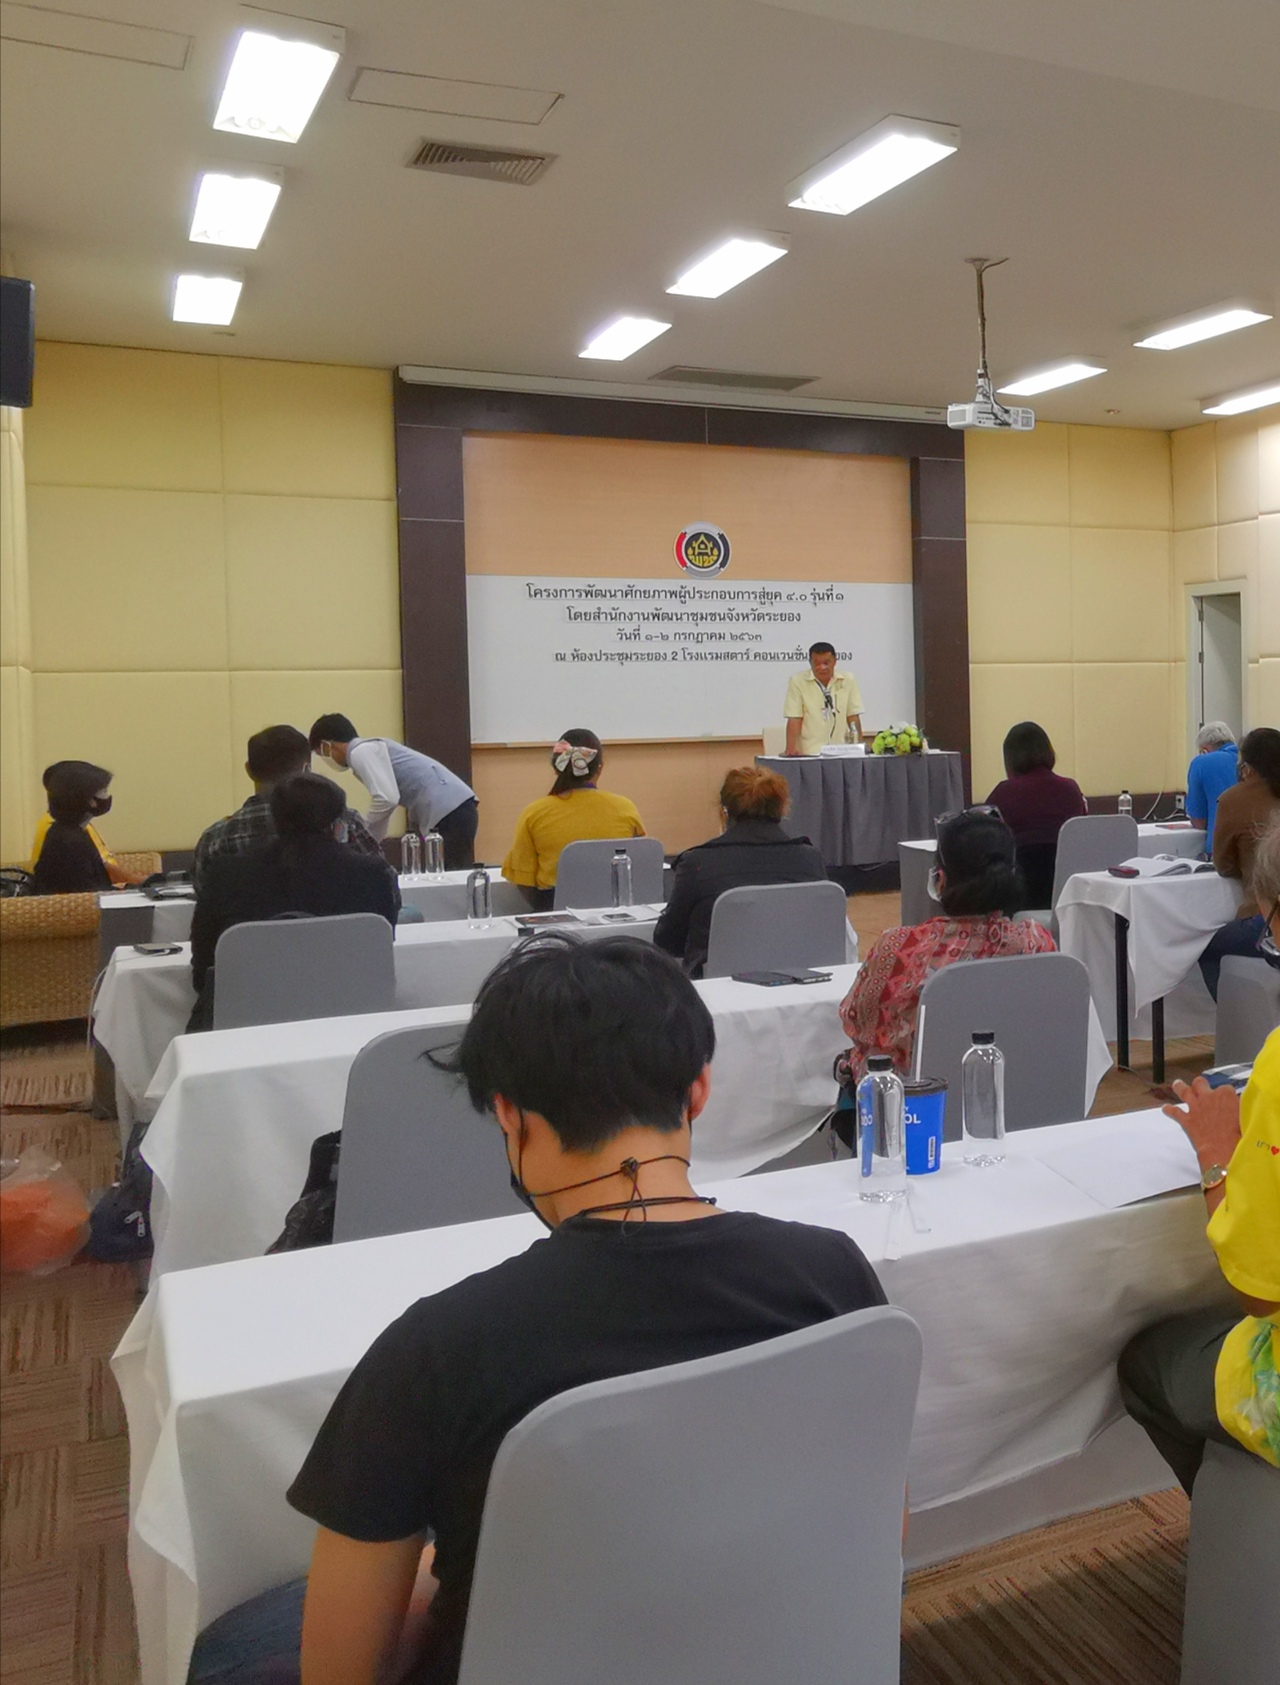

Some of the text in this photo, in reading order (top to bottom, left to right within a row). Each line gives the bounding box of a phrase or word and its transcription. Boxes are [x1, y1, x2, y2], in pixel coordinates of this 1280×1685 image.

[526, 583, 782, 605] โครงการพัฒนาศักยภาพผู้ประกอบการสู่ยุค
[786, 593, 808, 602] ๔.๐
[566, 606, 801, 626] โดยสำนักงานพัฒนาชุมชนจังหวัดระยอง
[617, 625, 641, 641] วันที่
[673, 632, 726, 644] กรกฎาคม
[730, 632, 763, 642] ๒๕๖๓
[555, 651, 567, 662] ณ
[571, 648, 668, 665] ห้องประชุมระยอง
[671, 651, 679, 661] 2
[681, 648, 750, 662] โรงแรมสตาร์
